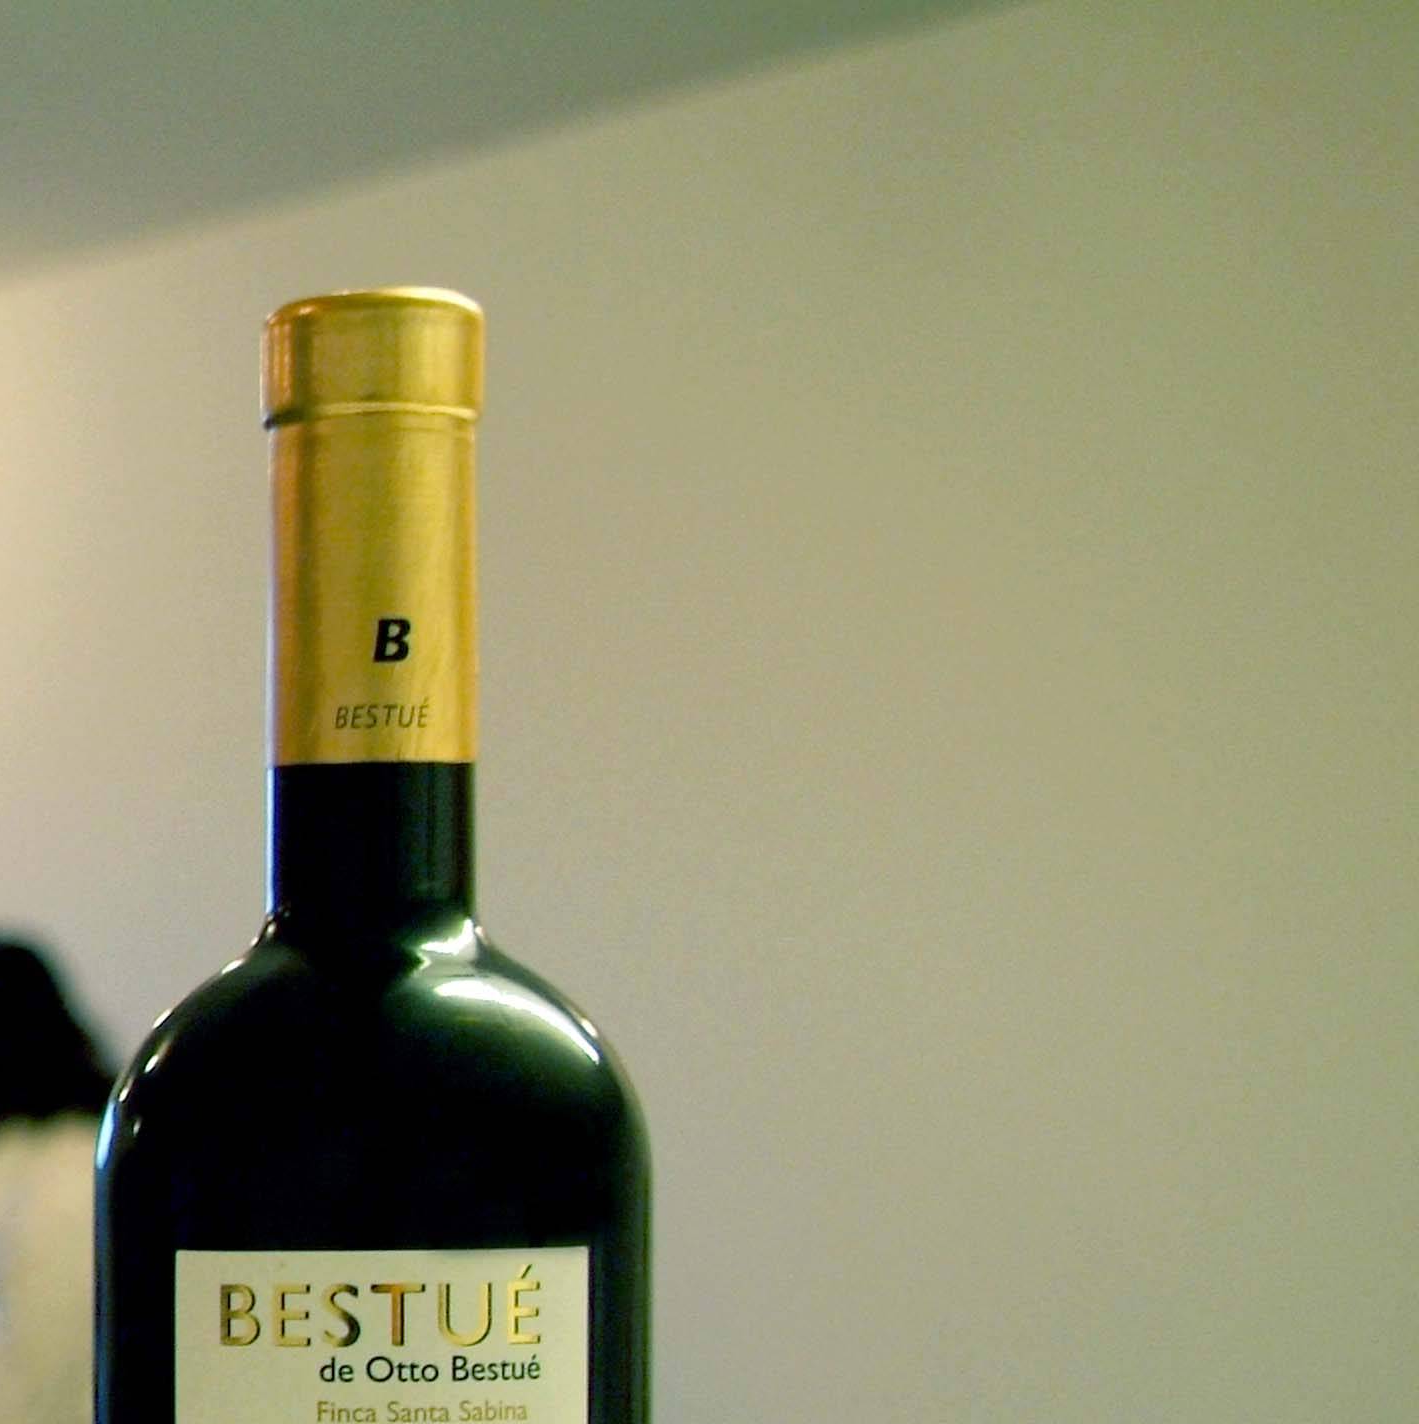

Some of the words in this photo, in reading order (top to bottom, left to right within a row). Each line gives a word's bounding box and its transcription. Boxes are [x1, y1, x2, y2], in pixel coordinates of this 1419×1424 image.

[373, 618, 411, 663] B
[334, 697, 430, 730] BESTUÉ
[220, 1264, 541, 1347] BESTUÉ
[319, 1357, 354, 1382] de
[366, 1356, 439, 1383] Otto
[452, 1354, 541, 1381] Bestué
[316, 1401, 377, 1423] Finca
[387, 1401, 449, 1422] Santa
[459, 1400, 528, 1422] Sabina
